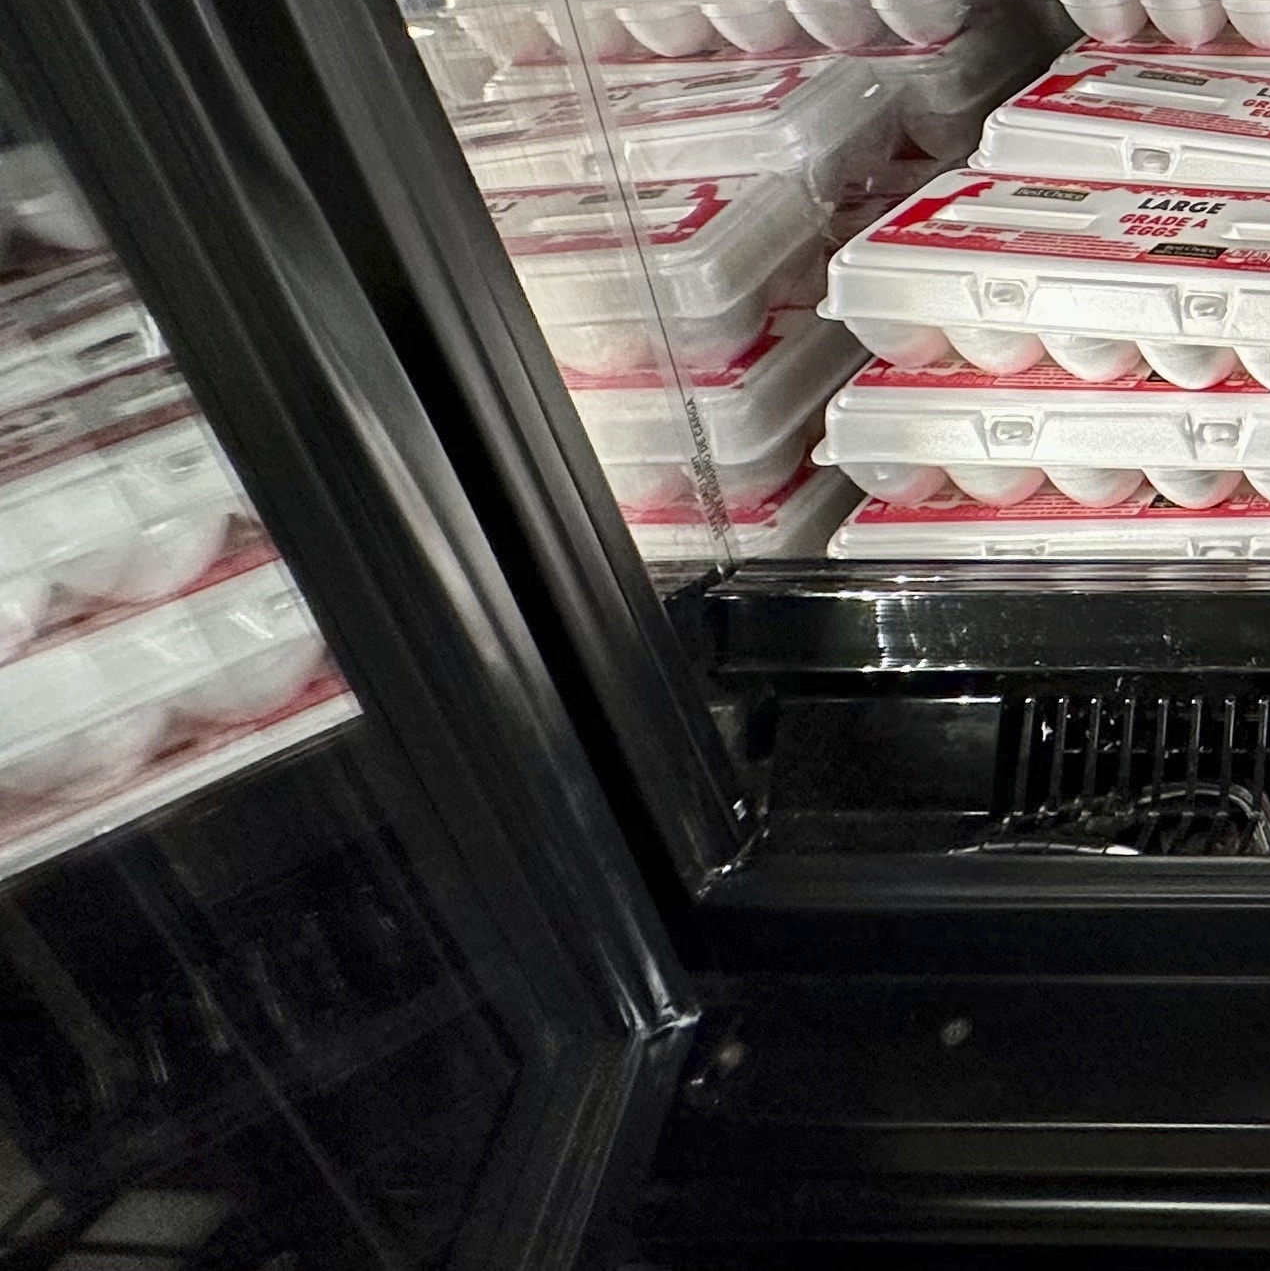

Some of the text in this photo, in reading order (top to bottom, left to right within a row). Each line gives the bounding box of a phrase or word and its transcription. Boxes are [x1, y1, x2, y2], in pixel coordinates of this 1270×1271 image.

[1137, 197, 1226, 215] LARGE
[1118, 213, 1209, 230] GRADE A
[1122, 222, 1183, 238] EGGS
